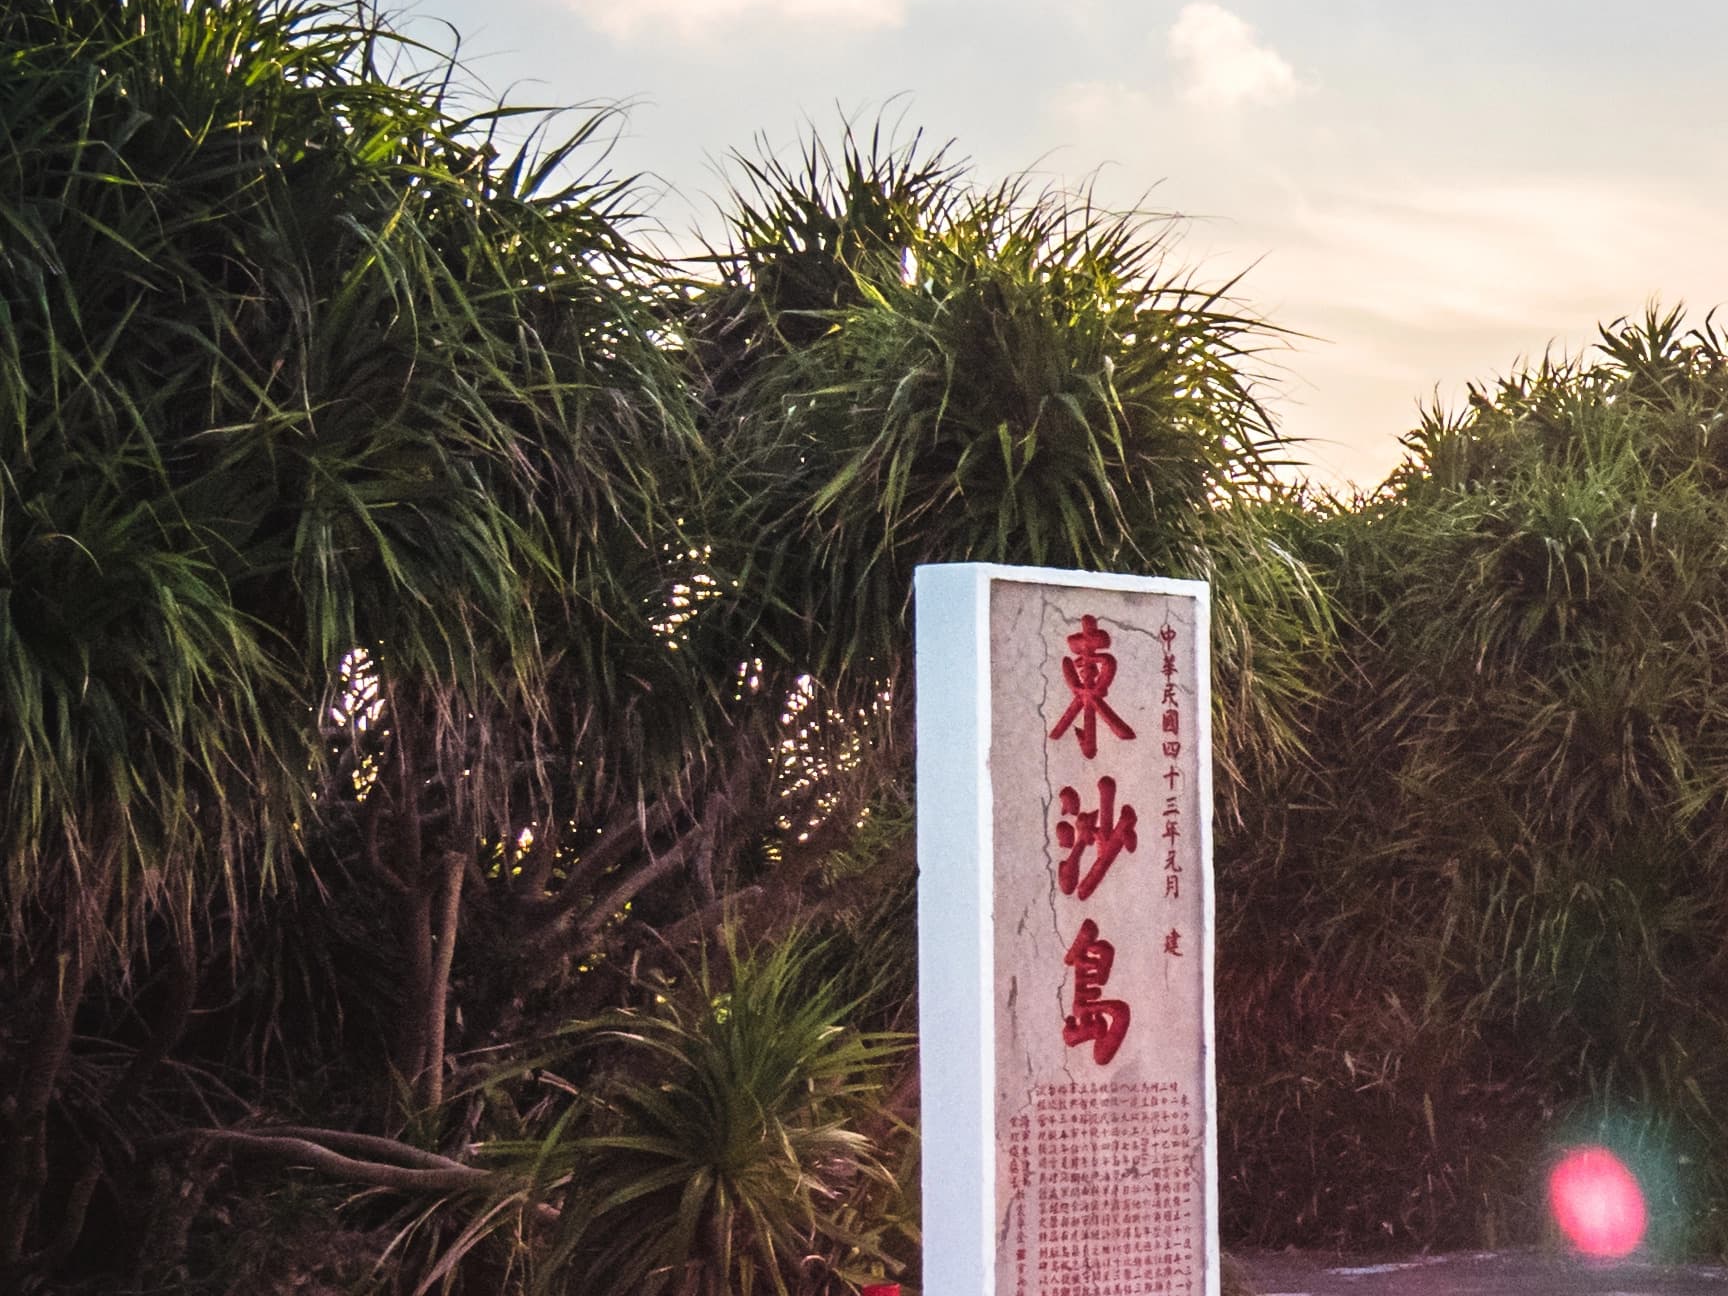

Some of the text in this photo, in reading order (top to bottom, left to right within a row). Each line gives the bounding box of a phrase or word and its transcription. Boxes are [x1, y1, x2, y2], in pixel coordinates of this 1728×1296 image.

[1048, 615, 1137, 1067] 東沙島
[1160, 624, 1183, 957] 中華民國四十三年元月 建
